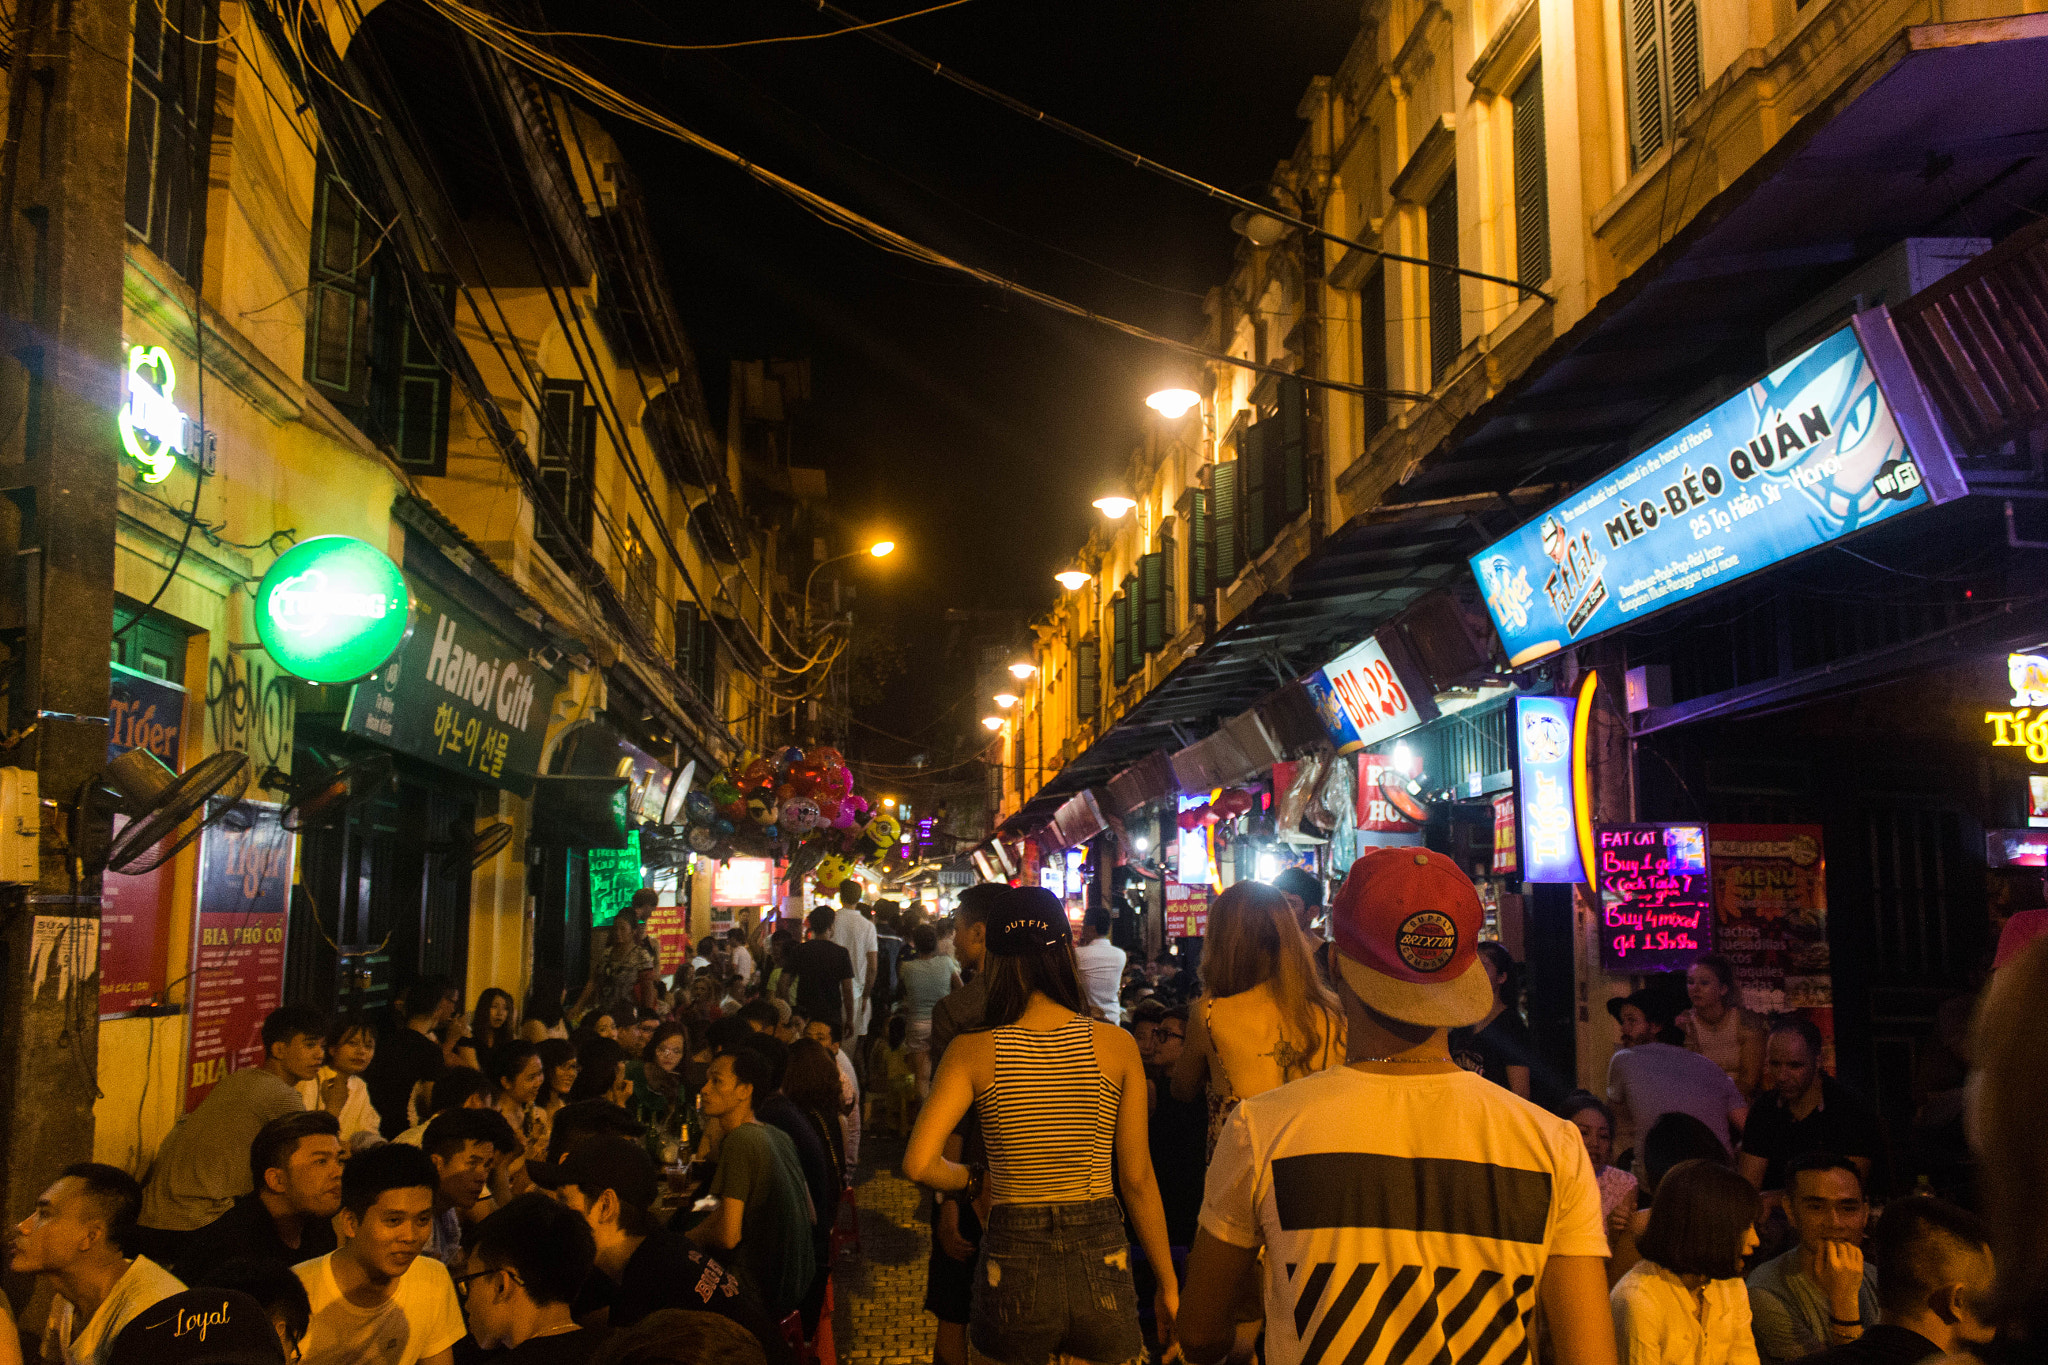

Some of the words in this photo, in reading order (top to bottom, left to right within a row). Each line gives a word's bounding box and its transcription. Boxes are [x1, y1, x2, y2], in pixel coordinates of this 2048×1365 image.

[1688, 423, 1713, 448] Hanoi
[1604, 464, 1722, 548] MÈO-BÉO
[1730, 404, 1832, 482] QUÁN
[1689, 515, 1712, 541] 25
[1708, 507, 1731, 533] Tạ
[1761, 483, 1782, 507] Str
[1790, 448, 1843, 489] Hanoi
[1701, 560, 1719, 578] and
[1488, 565, 1533, 627] Tiger
[426, 613, 500, 711] Hanoi
[496, 662, 535, 733] Gift
[1333, 669, 1381, 729] BIA
[1363, 659, 1408, 717] 23
[110, 699, 178, 757] Tiger
[434, 702, 482, 768] 하노이
[478, 727, 509, 779] 선물
[1528, 770, 1571, 865] Tiger
[1601, 831, 1631, 848] FAT
[1633, 831, 1657, 846] CAT
[224, 829, 280, 899] Tiger
[1603, 850, 1639, 879] Buy
[1735, 868, 1797, 886] MENU
[1005, 919, 1048, 934] OUTFIX
[1409, 914, 1452, 932] SUPPLY
[1606, 904, 1643, 931] Buy
[1645, 910, 1658, 928] 4
[1658, 911, 1700, 929] mixed
[203, 927, 229, 946] BIA
[1400, 934, 1455, 948] BRIXTON
[1613, 935, 1635, 957] get
[1642, 933, 1657, 950] 1
[1402, 946, 1450, 968] COMPANY
[191, 1057, 229, 1089] BIA
[146, 1301, 231, 1342] Loyal
